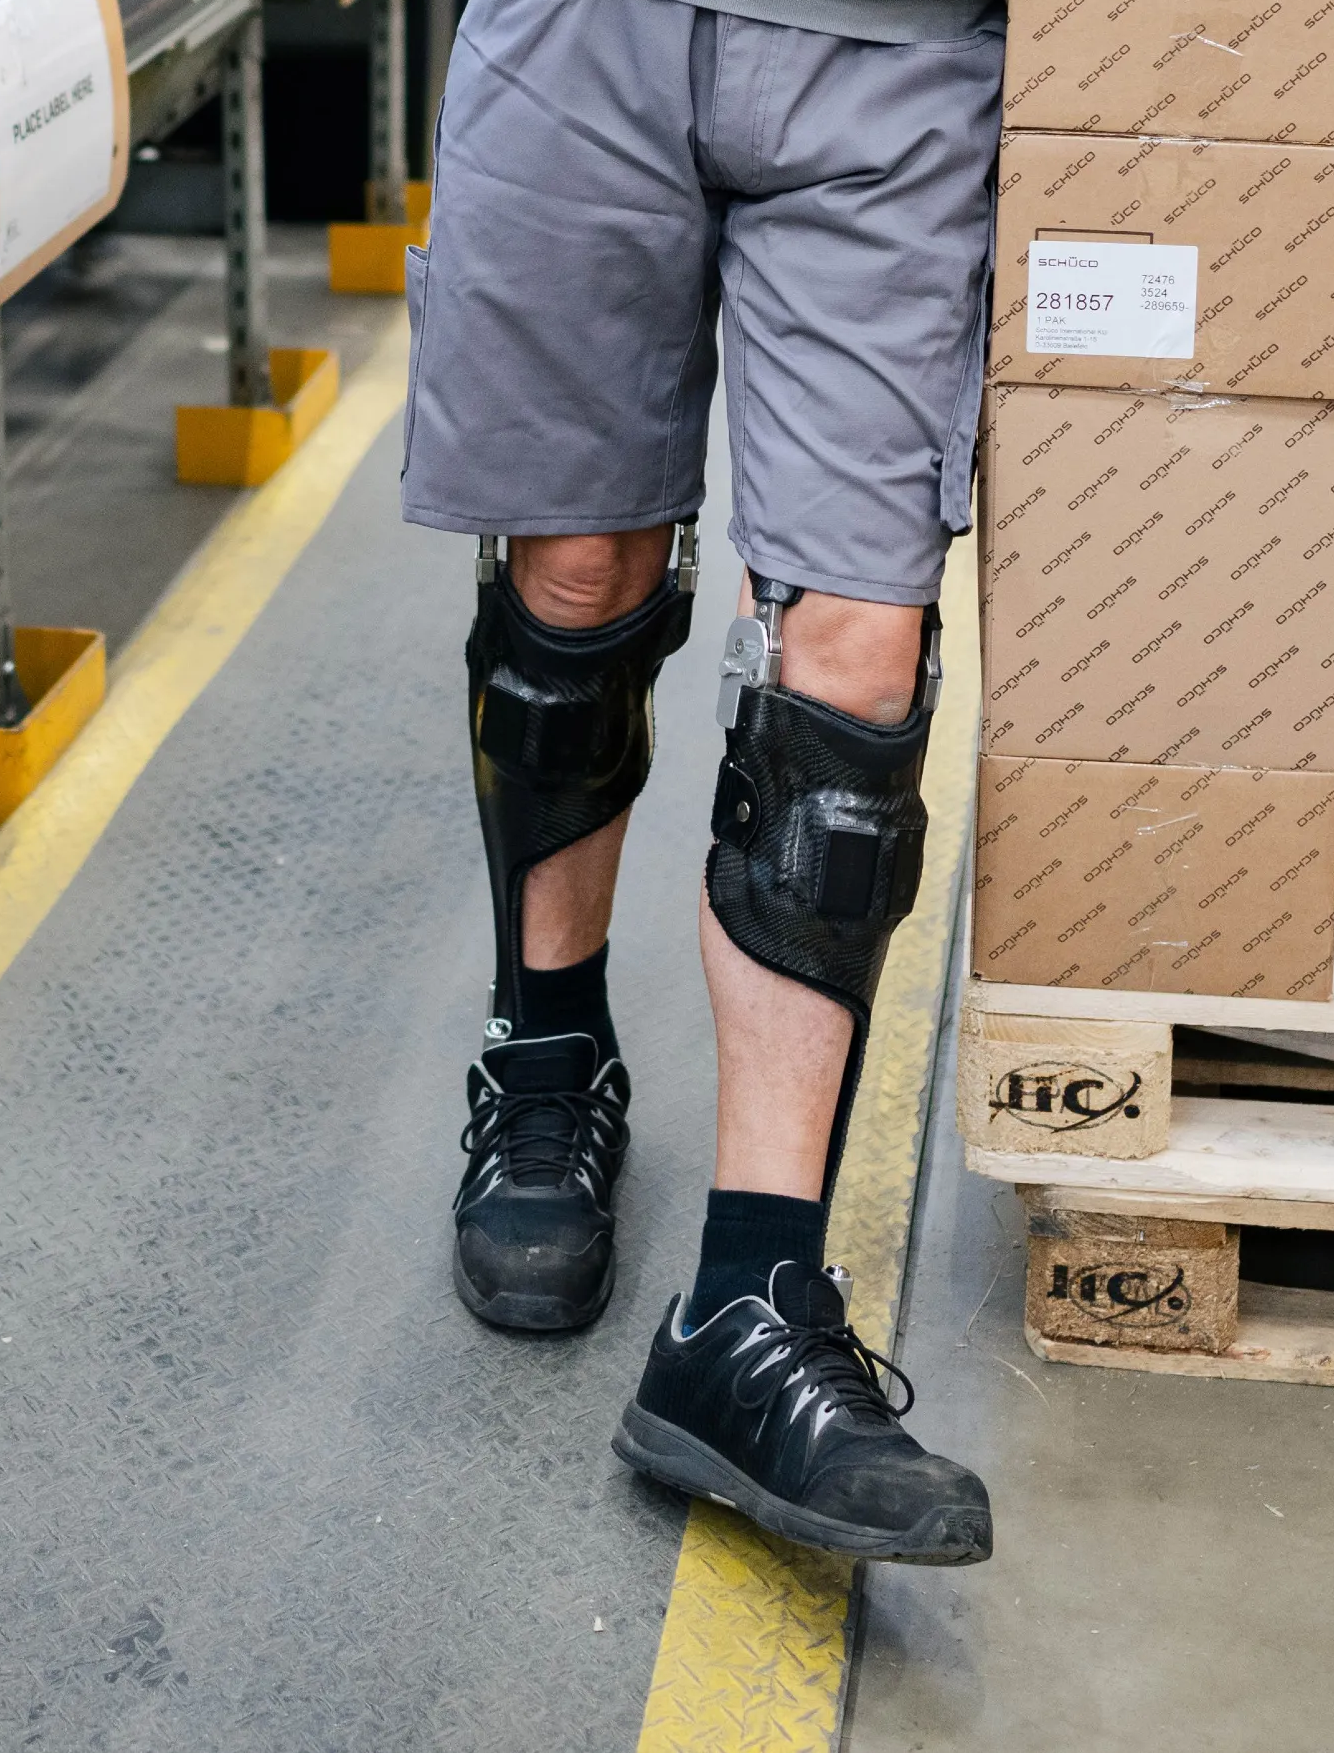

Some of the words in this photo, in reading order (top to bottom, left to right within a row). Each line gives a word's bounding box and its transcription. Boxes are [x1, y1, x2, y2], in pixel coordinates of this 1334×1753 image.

[12, 108, 42, 144] PLACE
[43, 91, 71, 124] LABEL
[72, 73, 94, 104] HERE
[1044, 152, 1095, 198] SCHÜCO
[1038, 256, 1099, 268] SCHÜCO
[1141, 275, 1175, 285] 72476
[1036, 292, 1114, 311] 281857
[1141, 287, 1168, 297] 3524
[1045, 316, 1067, 325] PAK
[1023, 421, 1072, 465] SCHÜCO
[1204, 601, 1254, 644] SCHÜCO
[1035, 702, 1084, 744] SCHÜCO
[1040, 795, 1088, 837] SCHÜCO
